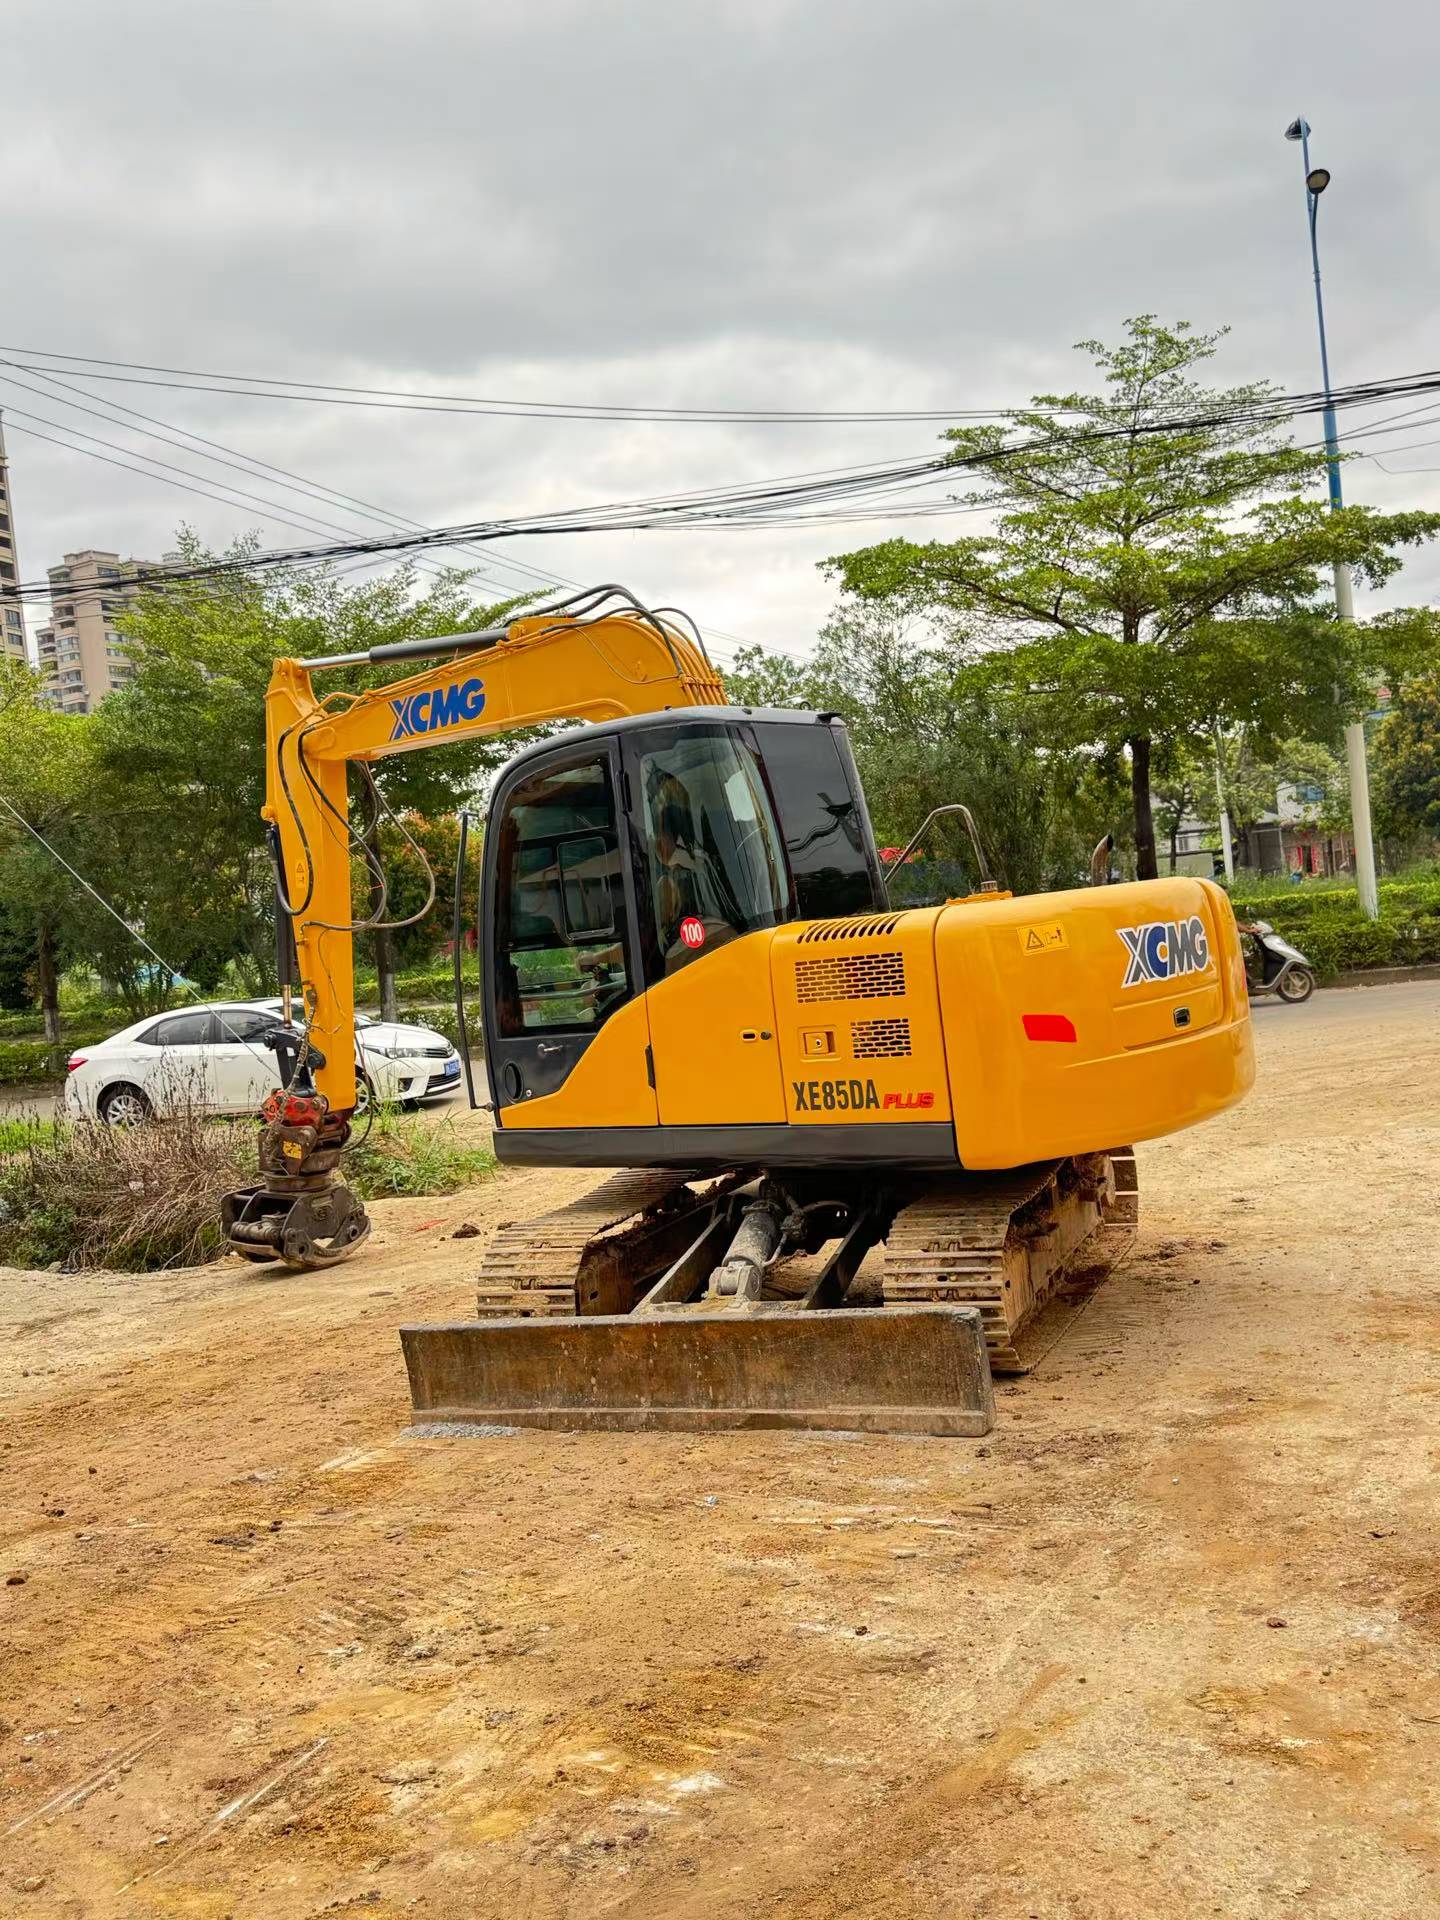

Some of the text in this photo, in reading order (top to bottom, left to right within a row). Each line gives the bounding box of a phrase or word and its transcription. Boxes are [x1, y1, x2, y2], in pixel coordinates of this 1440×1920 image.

[388, 678, 486, 741] XCMG
[682, 922, 704, 943] 100
[1116, 915, 1209, 988] XCMG
[792, 1079, 935, 1111] XE85DA PLUS
